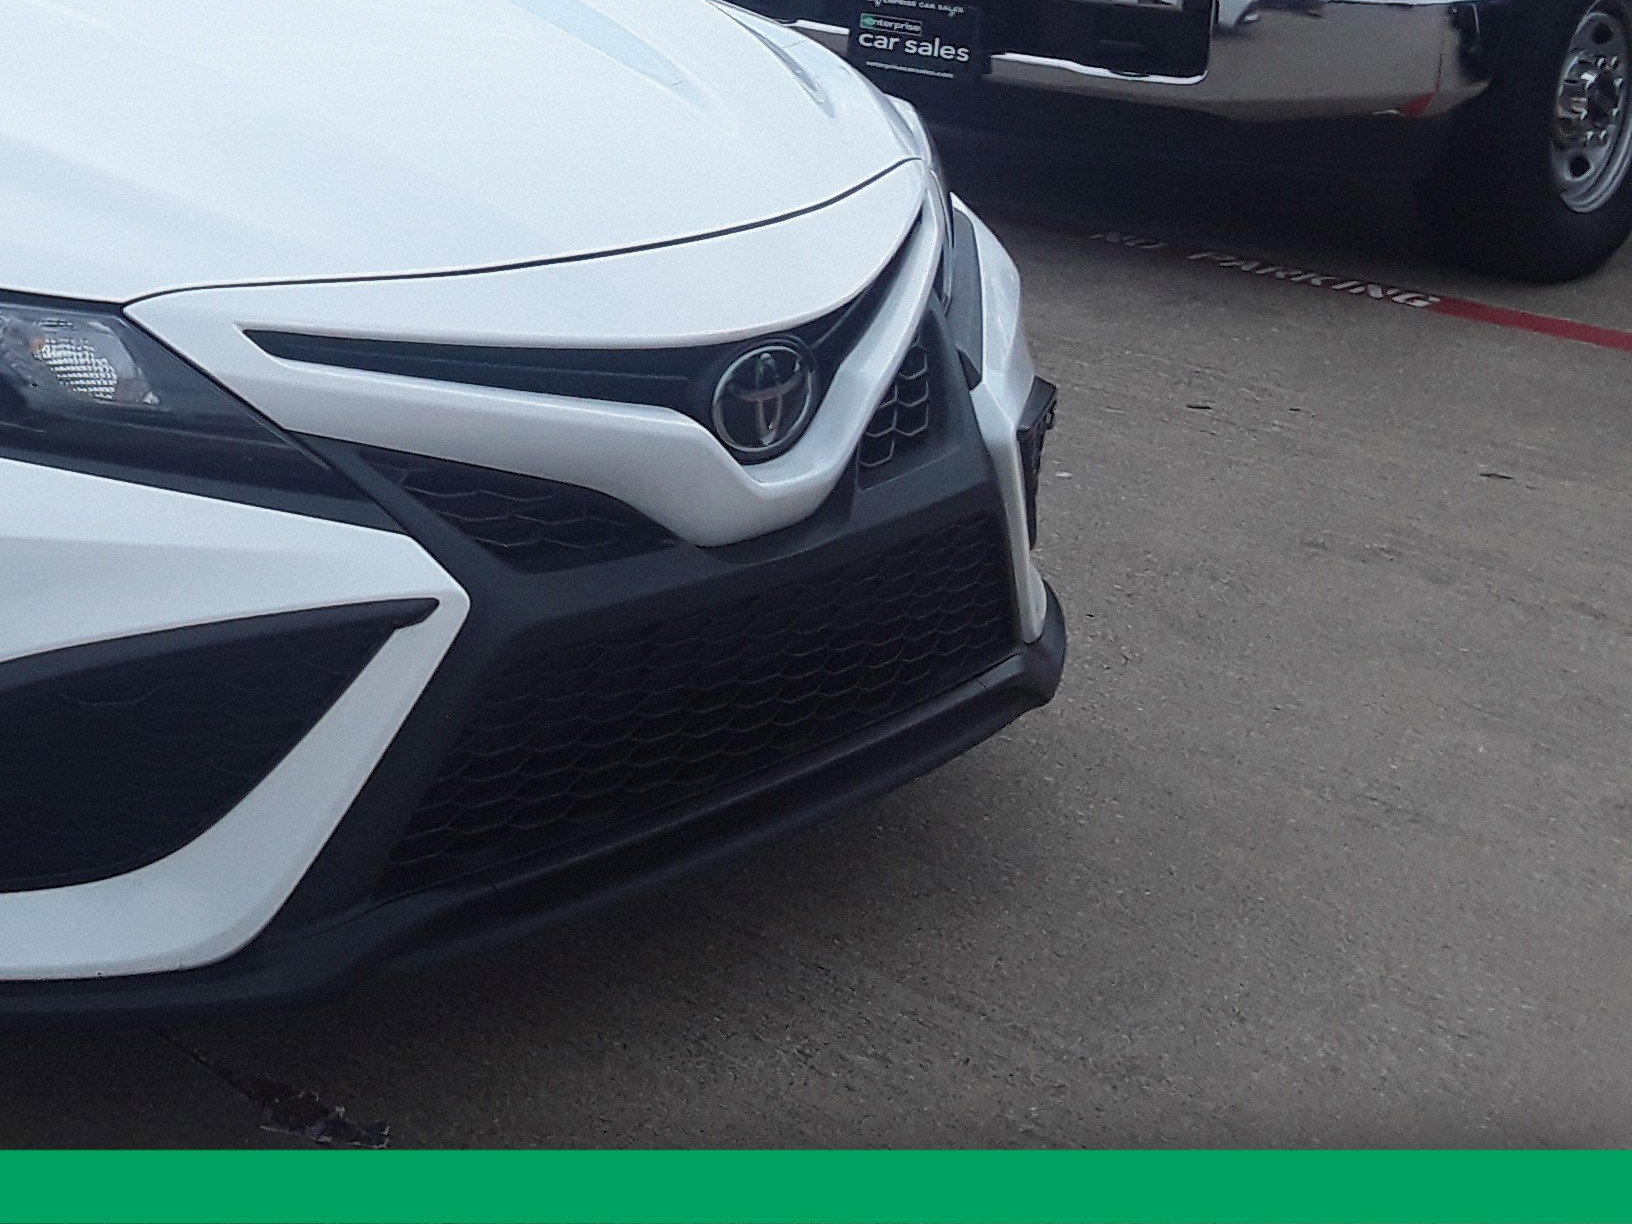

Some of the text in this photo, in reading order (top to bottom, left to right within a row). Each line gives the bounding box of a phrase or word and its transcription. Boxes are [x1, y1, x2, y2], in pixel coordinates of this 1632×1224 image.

[858, 33, 970, 62] car sales
[1186, 250, 1442, 308] PARKING
